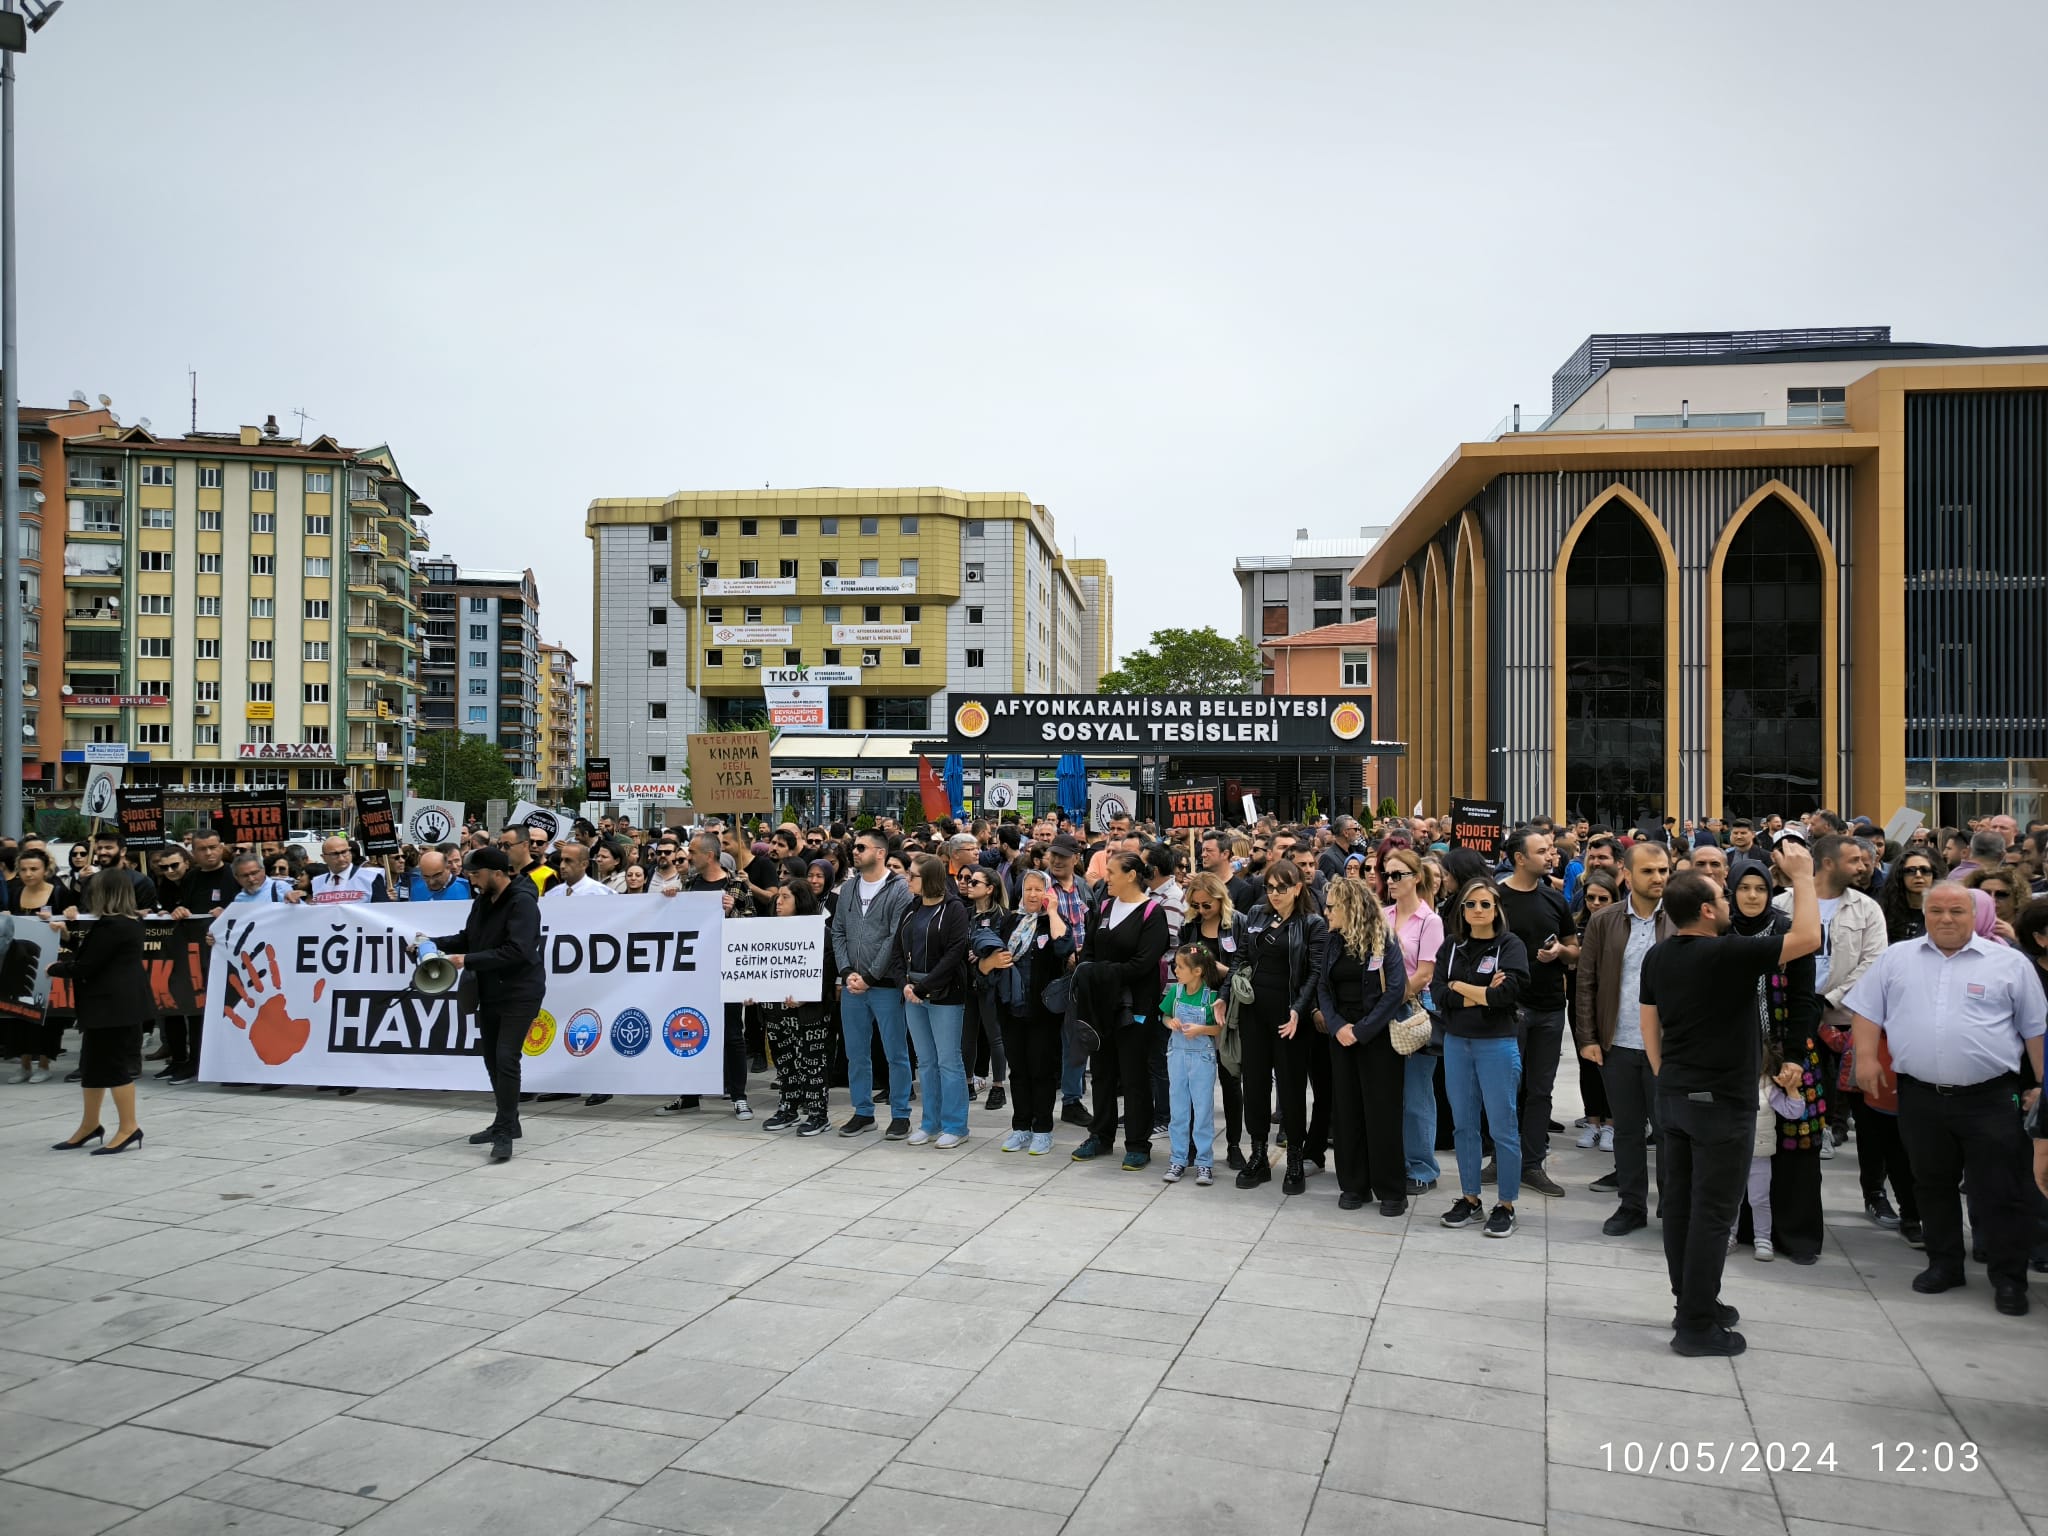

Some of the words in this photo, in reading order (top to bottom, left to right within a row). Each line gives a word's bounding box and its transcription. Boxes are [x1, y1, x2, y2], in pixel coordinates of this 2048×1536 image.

[769, 671, 809, 682] TKDK
[120, 697, 151, 705] EMLAK
[994, 698, 1192, 716] AFYONKARAHİSAR
[1200, 698, 1327, 716] BELEDİYESİ
[774, 715, 818, 725] BORÇLAR
[1041, 722, 1140, 741] SOSYAL
[1147, 719, 1279, 742] TESİSLERİ
[696, 736, 728, 745] YETER
[731, 735, 759, 745] ARTIK
[260, 744, 332, 752] ASYAM
[710, 746, 759, 760] KINAMA
[723, 759, 751, 770] DEĞİL
[716, 772, 753, 786] YASA
[22, 787, 44, 797] RTA
[618, 784, 675, 793] KARAMAN
[1168, 794, 1214, 812] YETER
[122, 808, 162, 824] ŞİDDETE
[230, 807, 282, 826] YETER
[362, 810, 393, 827] ŞİDDETE
[1172, 810, 1215, 828] ARTIK!
[129, 820, 158, 832] HAYIR
[368, 822, 390, 836] HAYIR
[526, 816, 556, 832] ŞİDDETE
[1456, 822, 1500, 840] ŞİDDETE
[1462, 838, 1492, 852] HAYIR
[143, 940, 162, 951] TIN
[537, 925, 700, 974] İDDETE
[728, 943, 748, 952] CAN
[751, 941, 816, 952] KORKUSUYLA
[736, 954, 768, 966] EĞİTİM
[770, 955, 807, 966] OLMAZ;
[720, 970, 768, 982] YAŞAMAK
[770, 968, 822, 979] İSTİYORUZ!
